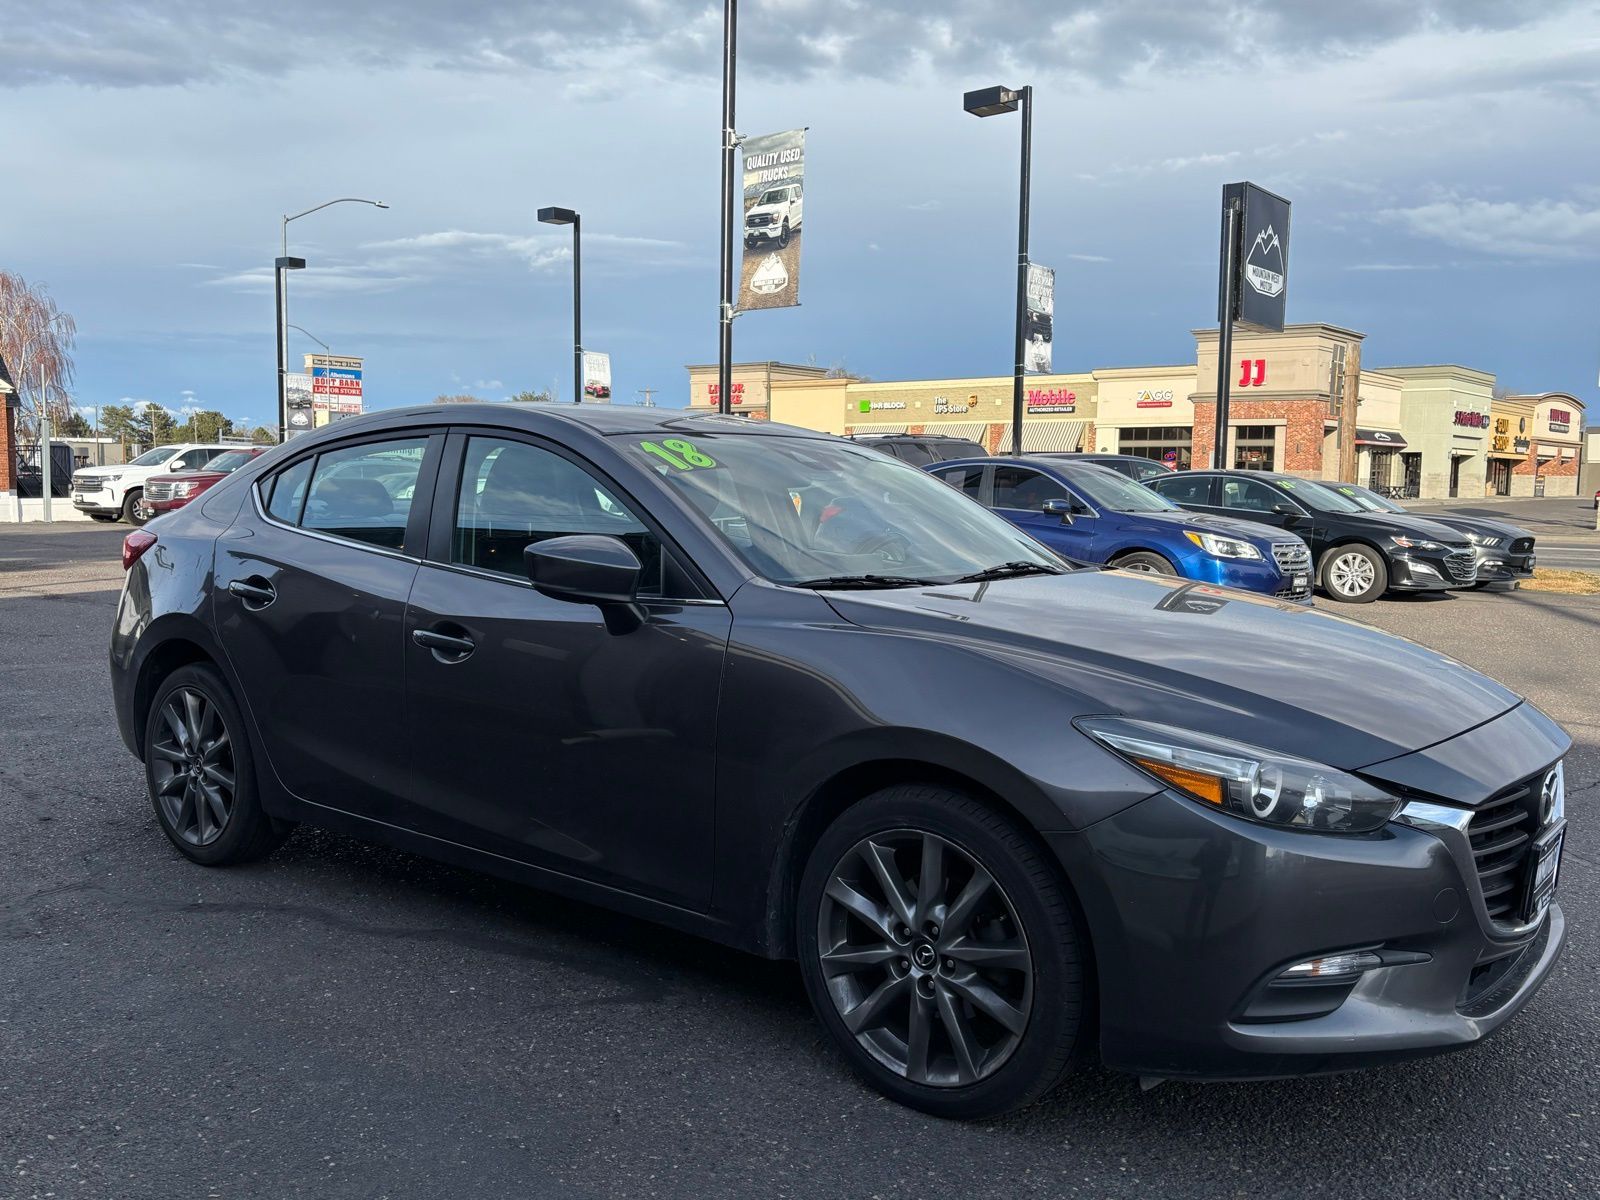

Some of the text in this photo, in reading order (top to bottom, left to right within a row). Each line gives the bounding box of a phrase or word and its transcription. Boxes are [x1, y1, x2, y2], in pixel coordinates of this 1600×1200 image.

[747, 148, 801, 170] QUALITY USED
[759, 167, 789, 182] TRUCKS
[1252, 266, 1280, 284] MOUNTAIN WEST
[1260, 280, 1273, 292] MOTOR
[340, 379, 360, 388] BARN
[708, 383, 745, 394] LIOR
[340, 388, 361, 396] STORE
[1027, 387, 1076, 406] Mobile
[1137, 389, 1173, 402] ZAGG
[710, 394, 743, 406] SRE
[884, 401, 906, 410] BLOCK
[935, 397, 947, 405] The
[934, 404, 968, 414] UPS Store
[640, 439, 717, 471] 18
